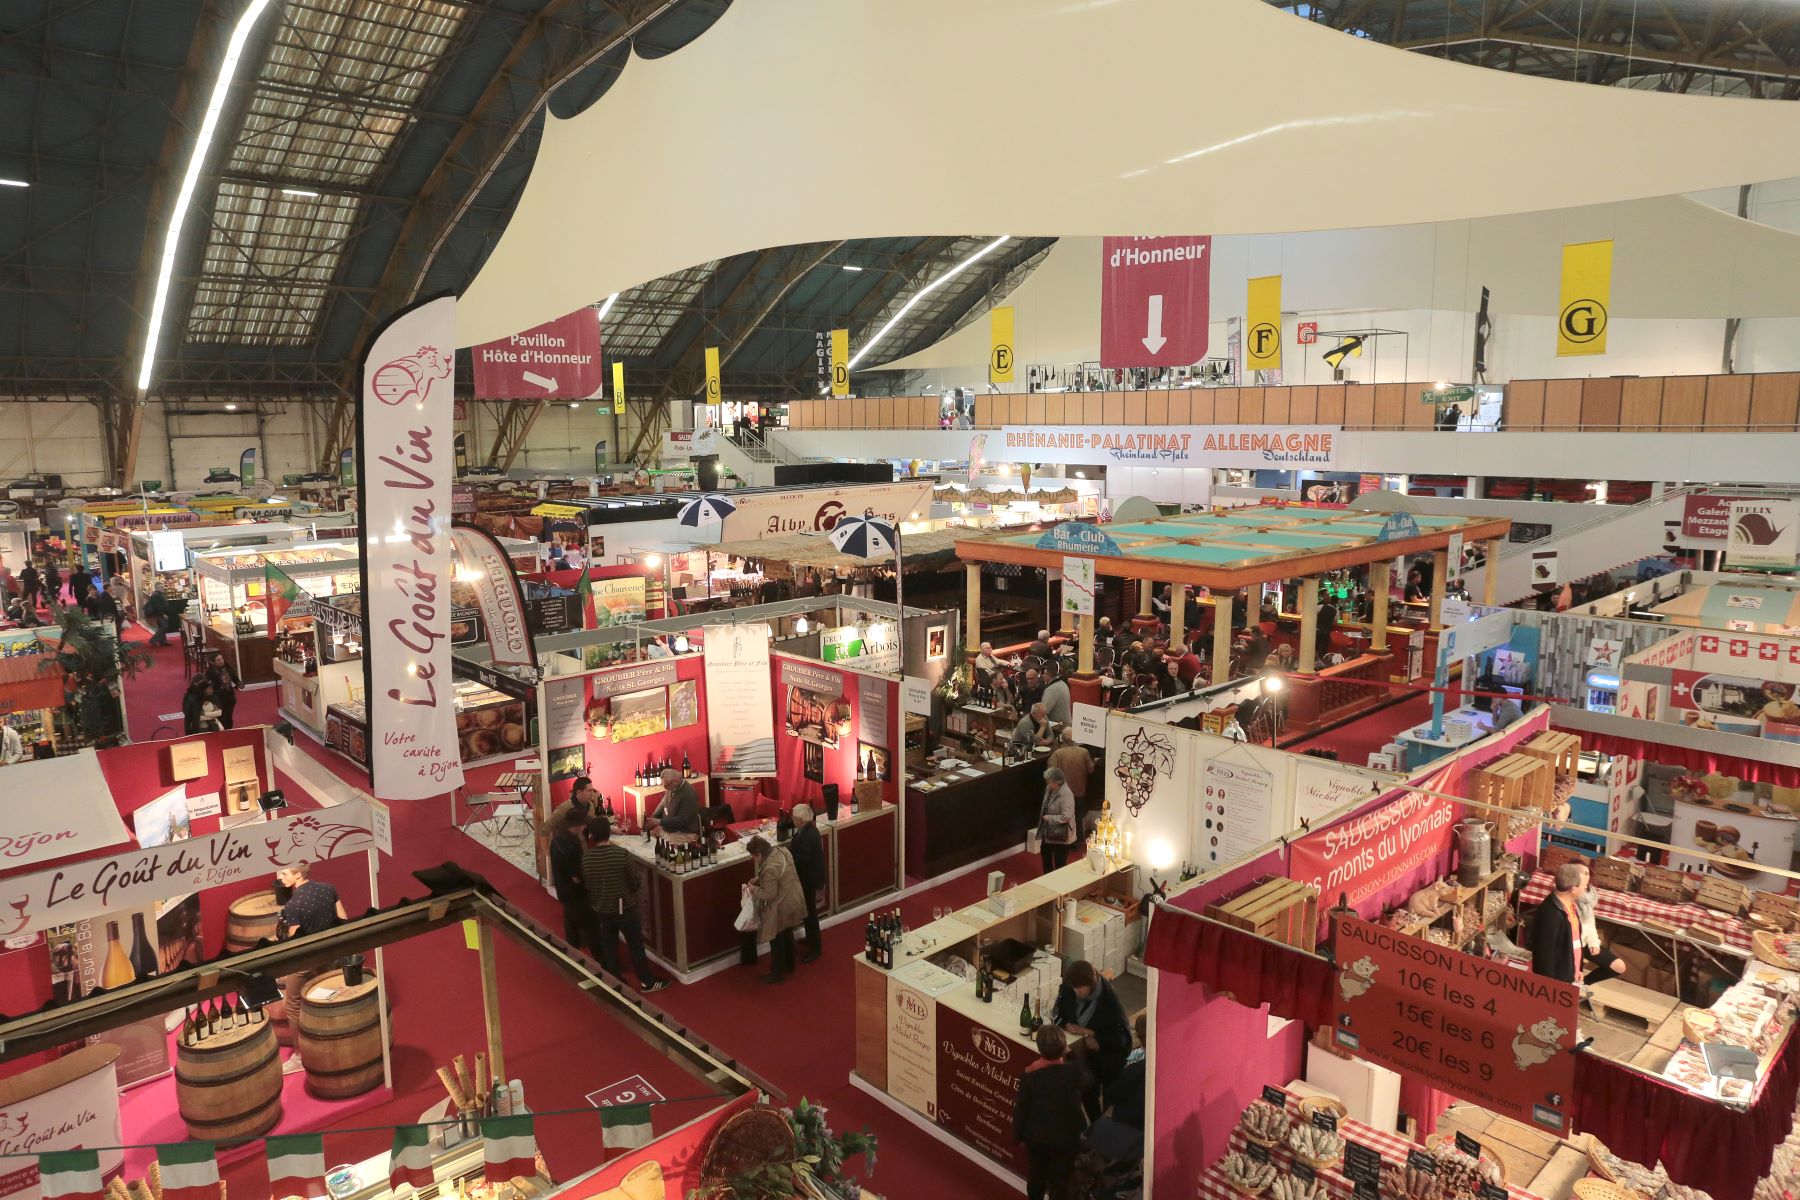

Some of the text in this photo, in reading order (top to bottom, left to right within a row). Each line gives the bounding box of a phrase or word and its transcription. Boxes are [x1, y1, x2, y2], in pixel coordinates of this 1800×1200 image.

[1111, 245, 1205, 267] d'Honneur
[1565, 306, 1597, 337] G
[510, 334, 565, 348] Pavillon
[1256, 329, 1273, 353] F
[483, 350, 591, 364] Hôte d'Honneur
[996, 349, 1010, 370] E
[836, 366, 847, 384] D
[709, 381, 718, 395] C
[1437, 388, 1468, 396] ORTIE
[1006, 430, 1332, 452] RHÉNANIE-PALATINAT ALLEMAGNE
[1736, 506, 1772, 514] HELIX
[156, 514, 192, 525] PASSION
[1054, 528, 1071, 539] Bar
[1080, 530, 1105, 543] Club
[1057, 540, 1100, 553] Rhumerie
[378, 426, 445, 709] Le Goût du Vin
[858, 638, 898, 656] Arbois
[594, 671, 636, 685] GROUBIER
[782, 663, 812, 676] GROUBIER
[384, 731, 416, 746] Votre
[403, 745, 442, 758] caviste
[430, 760, 459, 782] Dijon
[1327, 848, 1375, 890] monts
[1378, 834, 1396, 861] du
[1400, 803, 1453, 853] lyonnais
[46, 832, 252, 908] Le Goût du Vin
[207, 865, 241, 884] Dijon
[80, 942, 93, 955] la
[84, 957, 95, 975] sur
[1341, 921, 1573, 1008] SAUCISSON LYONNAIS
[1398, 968, 1497, 1016] 10€ les 4
[1396, 1001, 1495, 1049] 15€ les 6
[1392, 1030, 1493, 1081] 20€ les 9
[24, 1126, 57, 1154] Goût
[57, 1122, 75, 1135] du
[77, 1109, 96, 1126] Vin
